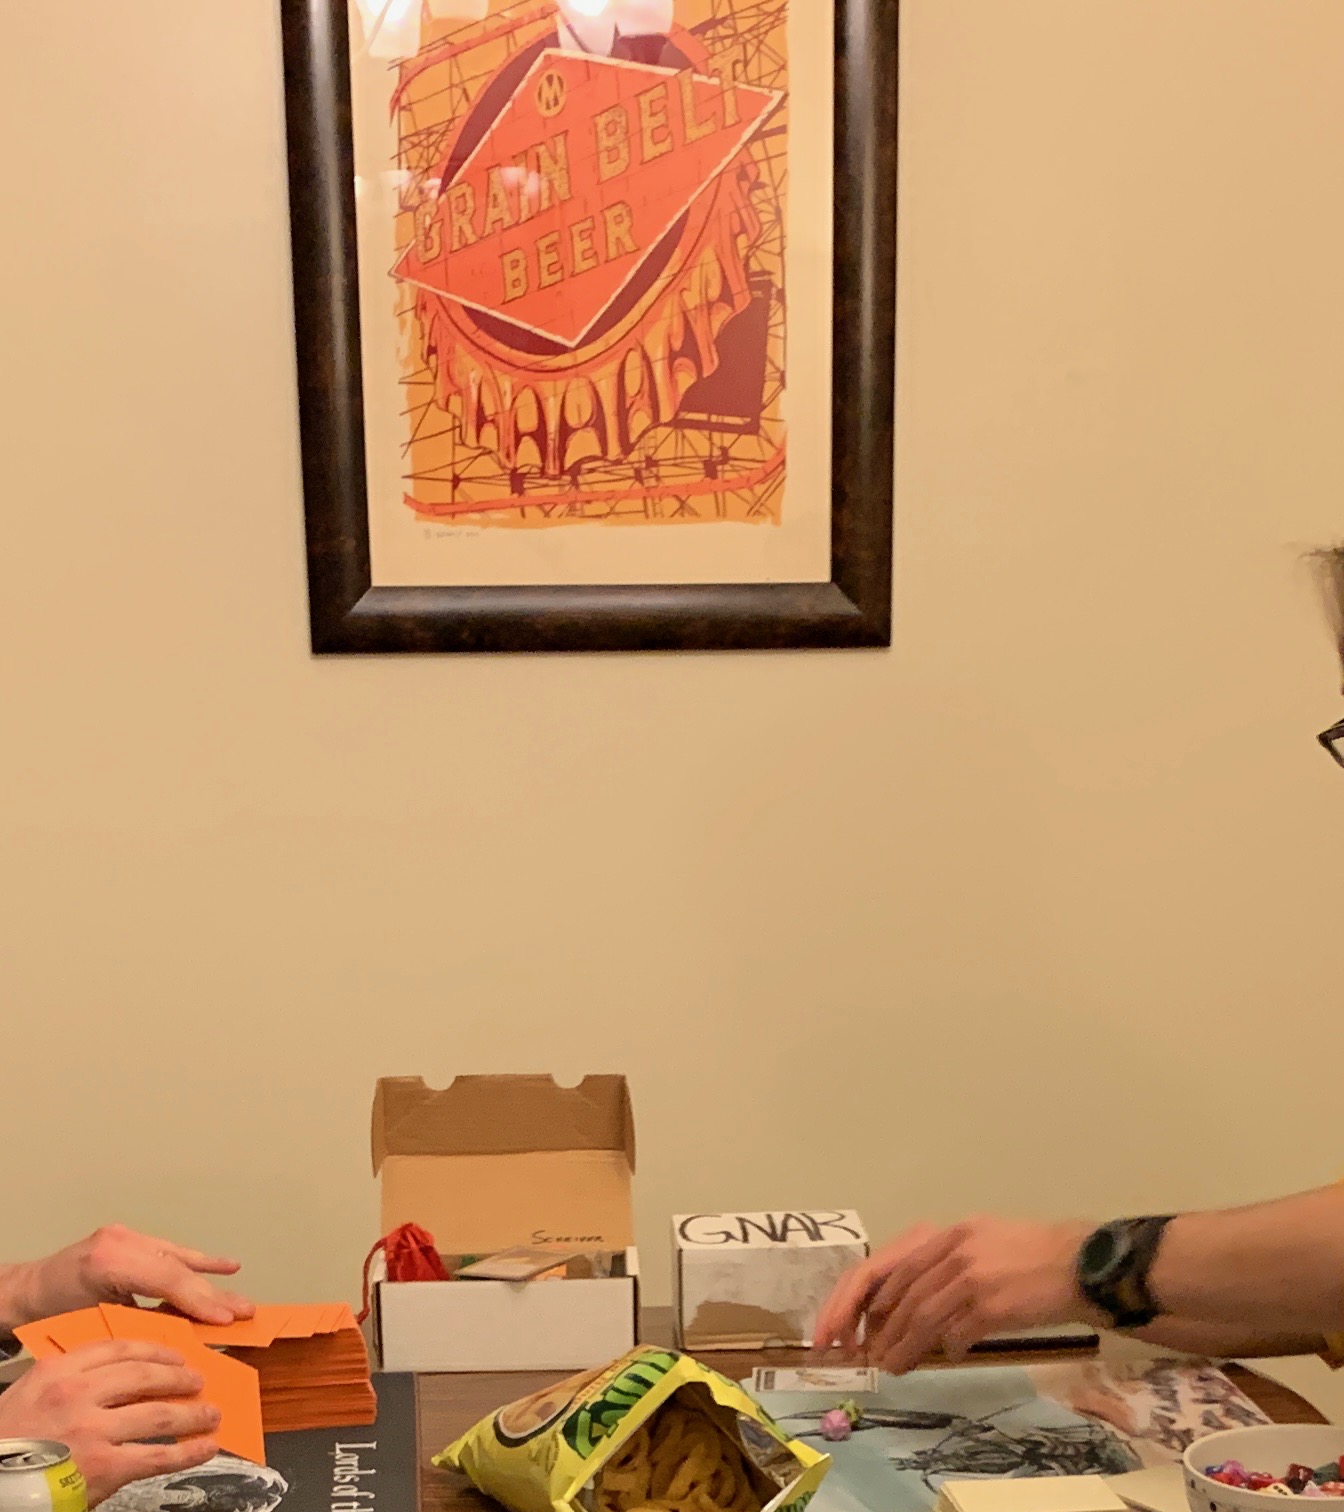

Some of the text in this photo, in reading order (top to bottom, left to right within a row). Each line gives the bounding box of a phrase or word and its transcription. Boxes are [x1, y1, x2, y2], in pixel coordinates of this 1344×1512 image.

[414, 50, 747, 266] GRAIN BELT
[499, 200, 641, 306] BEER
[331, 1484, 375, 1499] of
